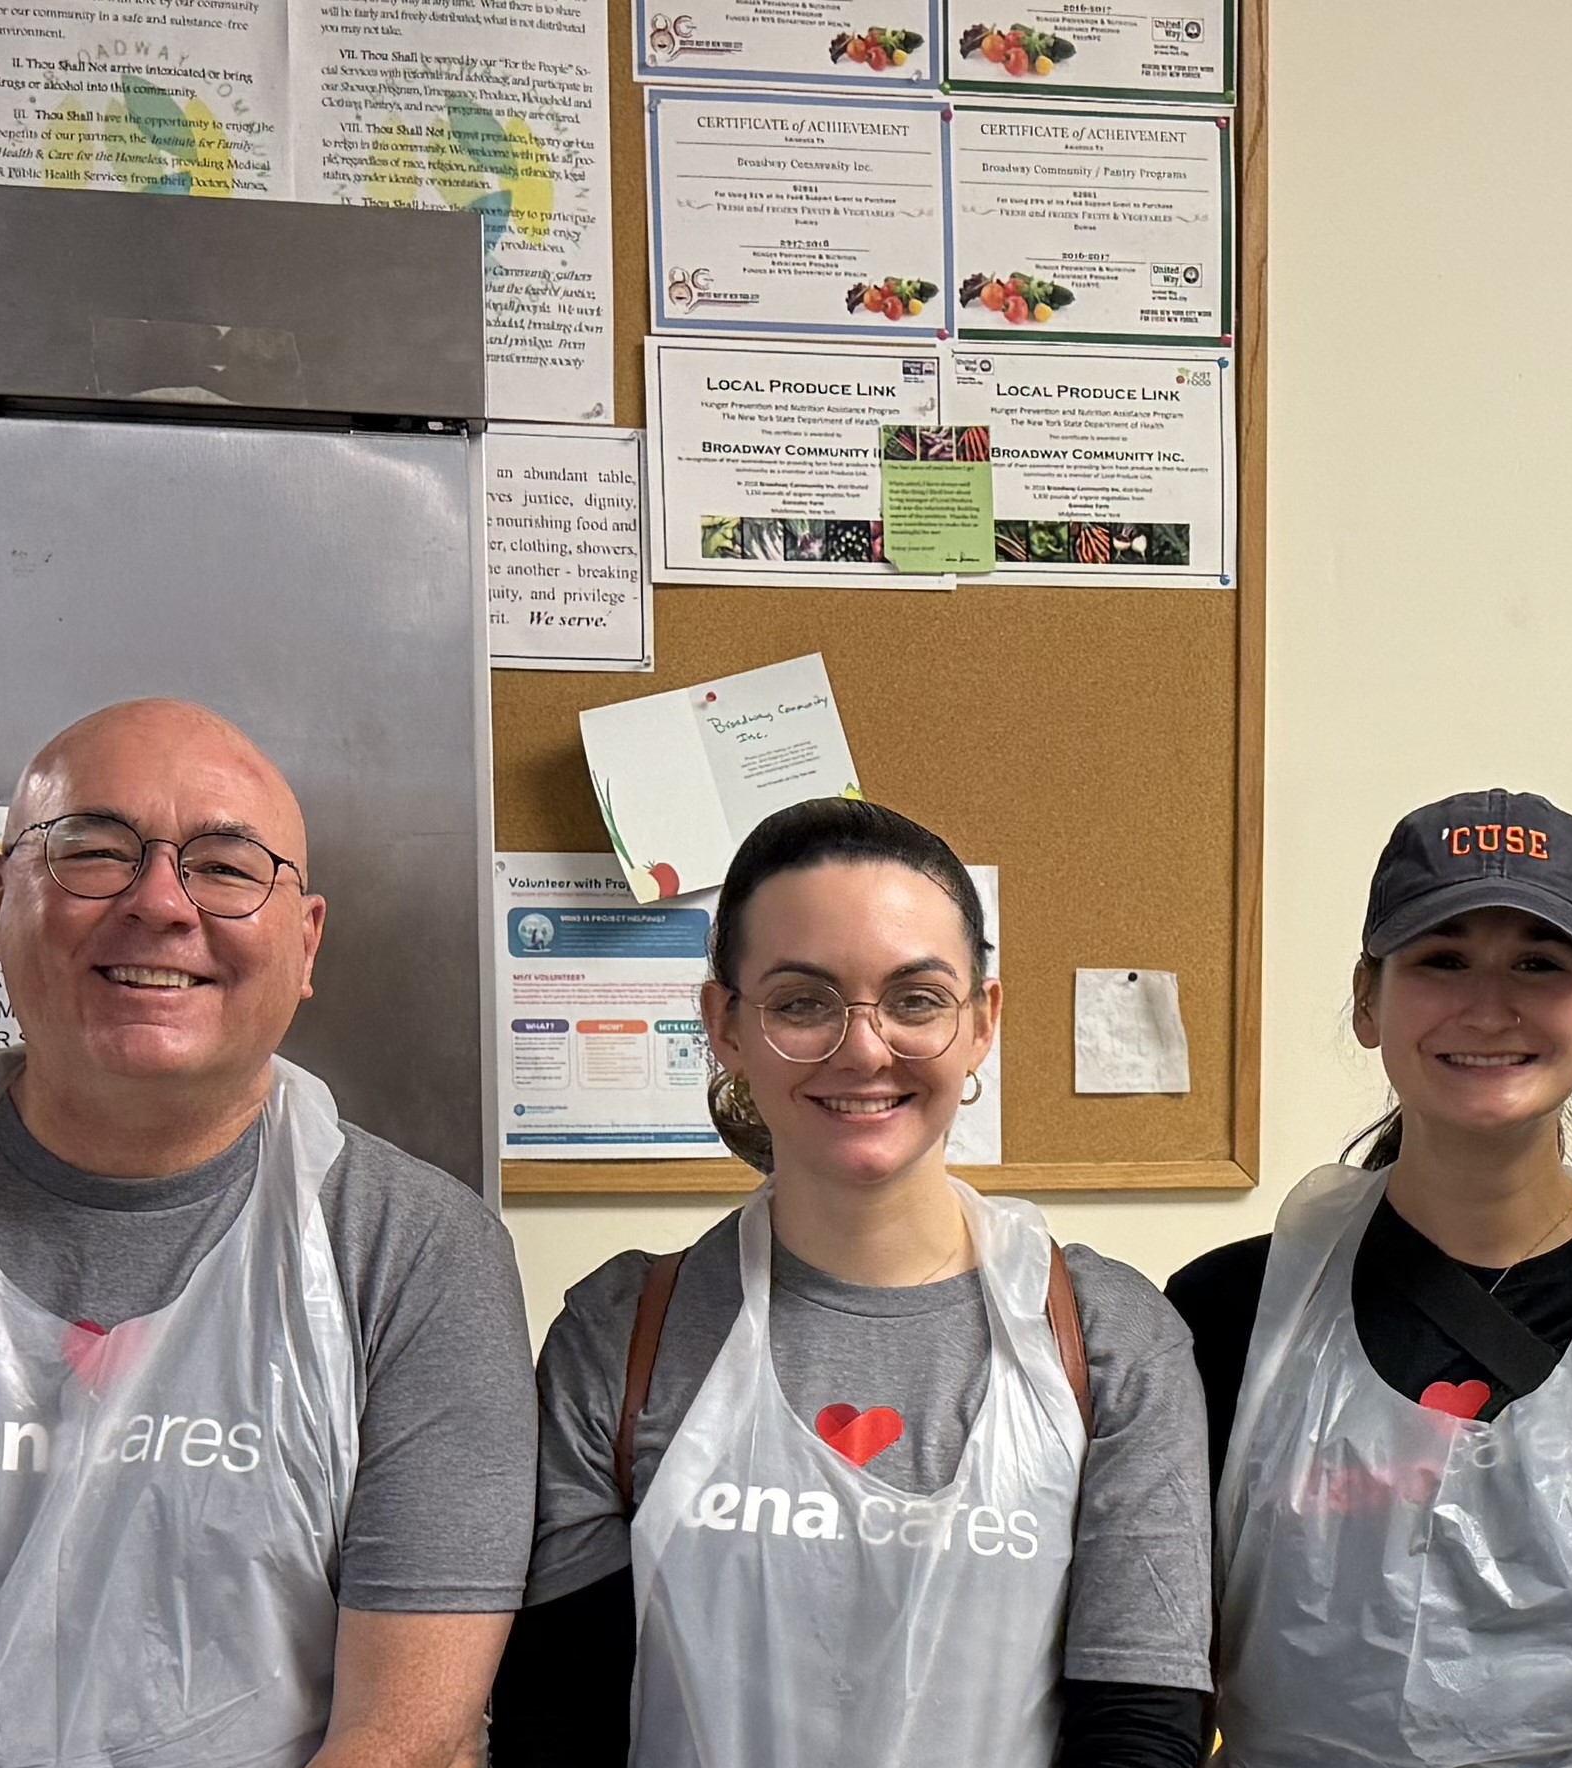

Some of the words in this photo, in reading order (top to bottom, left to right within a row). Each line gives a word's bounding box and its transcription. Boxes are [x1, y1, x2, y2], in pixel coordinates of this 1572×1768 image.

[361, 50, 388, 60] Thou
[392, 51, 417, 62] Shall
[25, 58, 55, 69] Thou
[89, 62, 107, 72] Not
[110, 63, 142, 74] arrive
[224, 70, 252, 84] bring
[29, 81, 41, 89] or
[44, 81, 83, 91] alcohol
[87, 82, 108, 92] into
[697, 116, 788, 131] CERTIFICATE
[792, 120, 805, 133] of
[808, 120, 910, 136] ACHIEVEMENT
[980, 123, 1069, 139] CERTIFICATE
[1072, 127, 1087, 140] of
[982, 163, 1030, 175] Broadway
[1034, 165, 1092, 177] Community
[1104, 168, 1135, 179] Pantry
[1140, 168, 1187, 180] Programs
[707, 377, 764, 393] LOCAL
[769, 380, 852, 396] PRODUCE
[857, 383, 896, 398] LINK
[996, 383, 1052, 397] LOCAL
[1057, 385, 1137, 400] PRODUCE
[1142, 388, 1180, 401] LINK
[702, 441, 780, 455] BROADWAY
[785, 445, 869, 458] COMMUNITY
[991, 447, 1068, 459] BROADWAY
[1072, 449, 1153, 461] COMMUNITY
[1157, 451, 1184, 462] INC.
[497, 468, 513, 478] an
[524, 467, 588, 483] abundant
[598, 471, 636, 485] table,
[522, 491, 574, 507] justice,
[497, 515, 571, 533] nourishing
[577, 516, 607, 532] food
[612, 519, 637, 532] and
[511, 539, 572, 557] clothing,
[577, 541, 638, 556] showers,
[507, 563, 560, 576] another
[578, 564, 638, 582] breaking
[489, 586, 522, 602] uity,
[530, 587, 555, 600] and
[564, 589, 625, 606] privilege
[529, 611, 554, 625] We
[559, 614, 607, 627] serve.
[509, 878, 571, 889] Volunteer
[575, 878, 602, 889] with
[116, 1413, 263, 1474] ares
[858, 1495, 1040, 1561] cares
